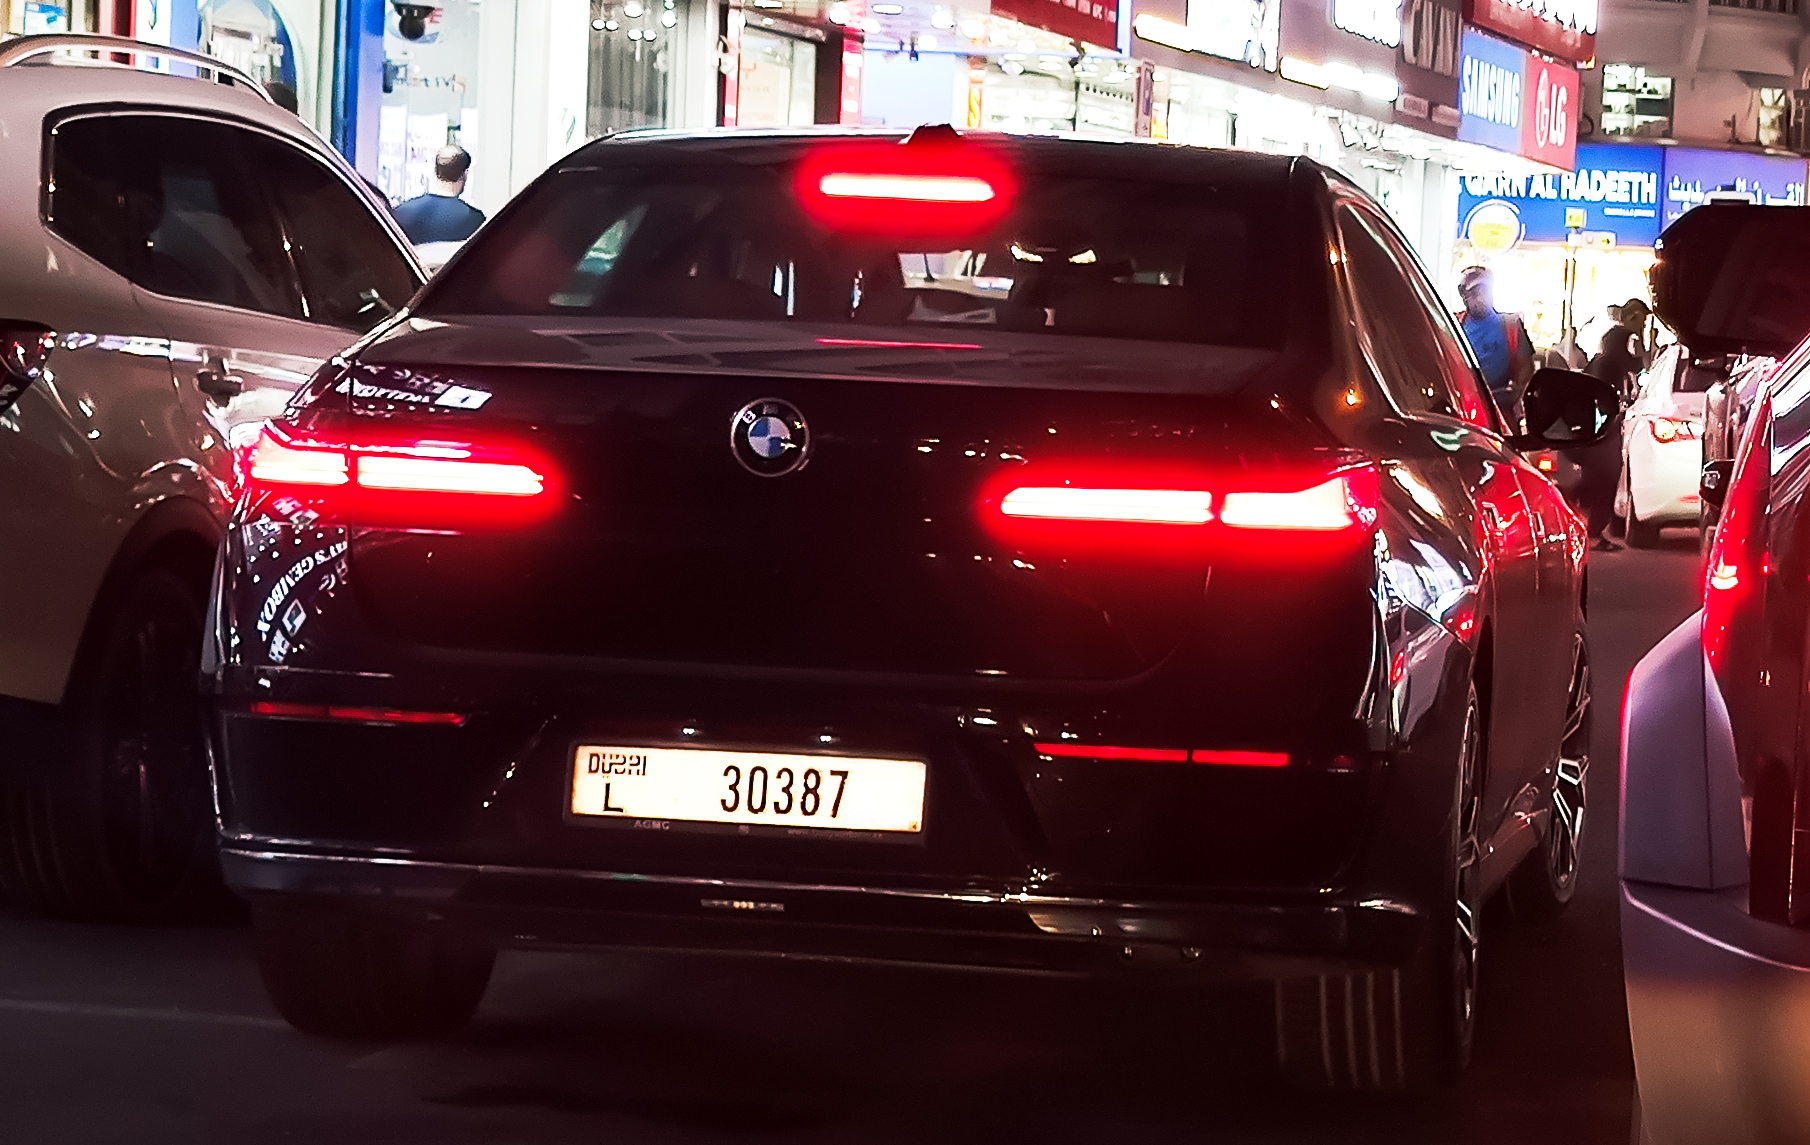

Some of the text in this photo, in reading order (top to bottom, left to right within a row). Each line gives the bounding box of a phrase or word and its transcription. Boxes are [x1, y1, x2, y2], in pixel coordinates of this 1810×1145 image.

[1461, 55, 1521, 128] SAMSUNG
[1549, 83, 1568, 147] LG
[1529, 173, 1558, 199] AL
[1560, 168, 1658, 204] HADEETH
[588, 752, 647, 776] DUBAI
[603, 765, 849, 819] L 30387
